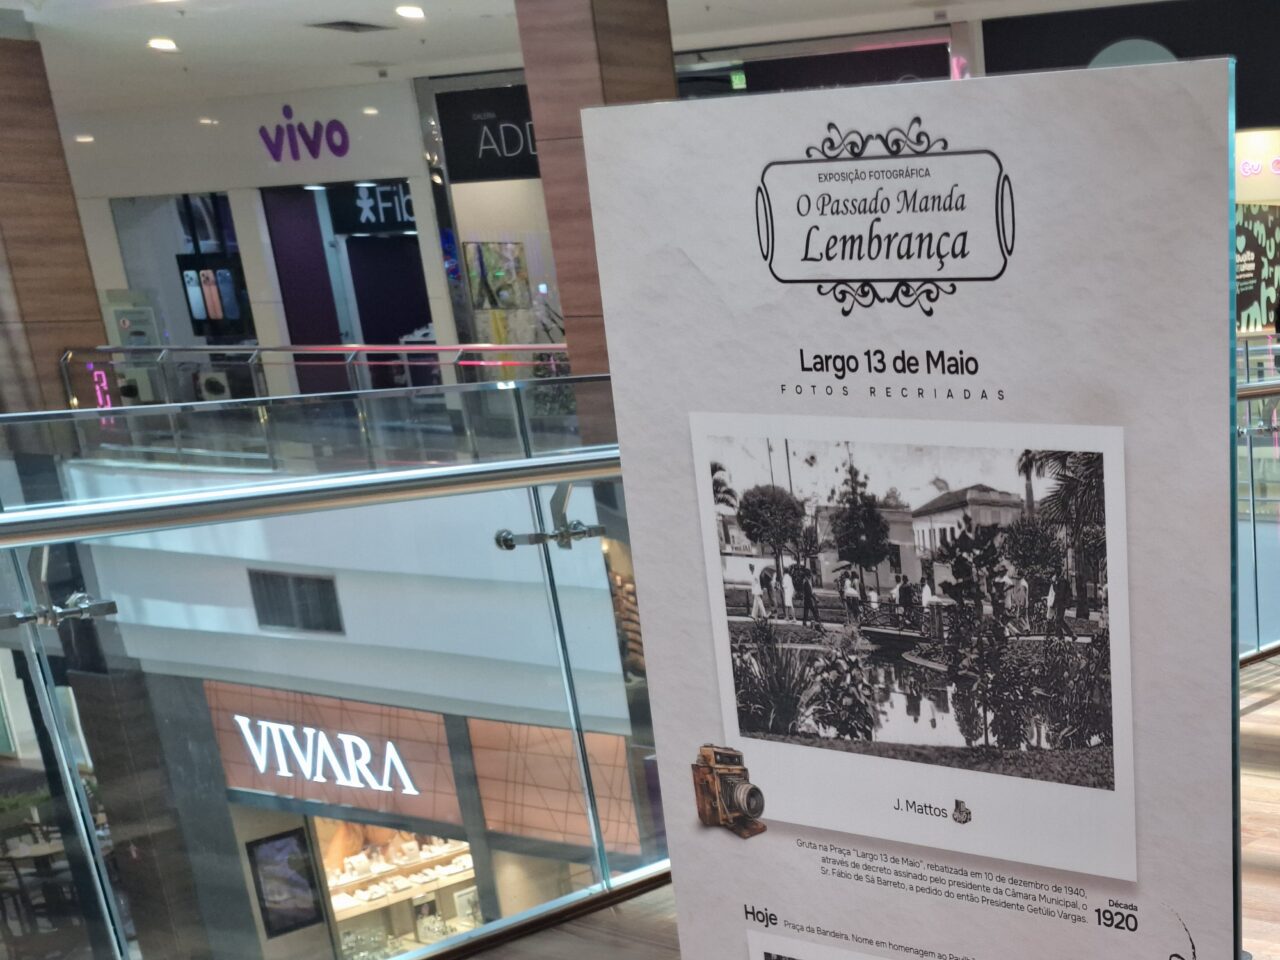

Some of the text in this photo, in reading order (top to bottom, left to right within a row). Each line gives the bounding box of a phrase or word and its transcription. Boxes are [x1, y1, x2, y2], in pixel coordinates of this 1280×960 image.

[259, 104, 350, 162] vivo
[818, 166, 931, 184] EXPOSIÇÃO FOTOGRÁFICA
[796, 184, 968, 217] O Passado Manda
[800, 217, 971, 272] Lembrança
[799, 348, 980, 380] Largo 13 de Maio
[780, 384, 1006, 401] FOTOS RECRIADAS
[233, 714, 420, 796] VIVARA
[893, 798, 949, 819] J. Mattos
[796, 838, 1088, 899] Gruta na Praça "Largo 13 de Maio", rebatizada em 10 de dezembro de 1940,
[821, 856, 850, 868] através
[850, 860, 861, 870] de
[861, 862, 892, 875] decreto
[893, 867, 928, 882] assinado
[929, 873, 947, 887] pelo
[947, 878, 991, 894] presidente
[992, 885, 1004, 896] da
[1004, 888, 1037, 902] Câmara
[1038, 893, 1081, 911] Municipal,
[820, 866, 831, 876] Sr.
[831, 868, 852, 880] Fábio
[853, 873, 864, 882] de
[865, 873, 876, 884] Sá
[876, 877, 908, 891] Barreto,
[915, 885, 943, 897] pedido
[944, 887, 955, 899] do
[956, 891, 980, 904] então
[981, 895, 1025, 912] Presidente
[1026, 904, 1056, 918] Getúlio
[1057, 910, 1089, 924] Vargas.
[1108, 899, 1139, 912] Década
[744, 904, 778, 928] Hoje
[1094, 908, 1139, 932] 1920
[783, 919, 805, 933] Praça
[805, 924, 815, 934] da
[816, 926, 850, 942] Bandeira.
[851, 933, 874, 946] Nome
[875, 939, 888, 949] em
[888, 940, 936, 959] homenagem
[937, 951, 948, 960] ao
